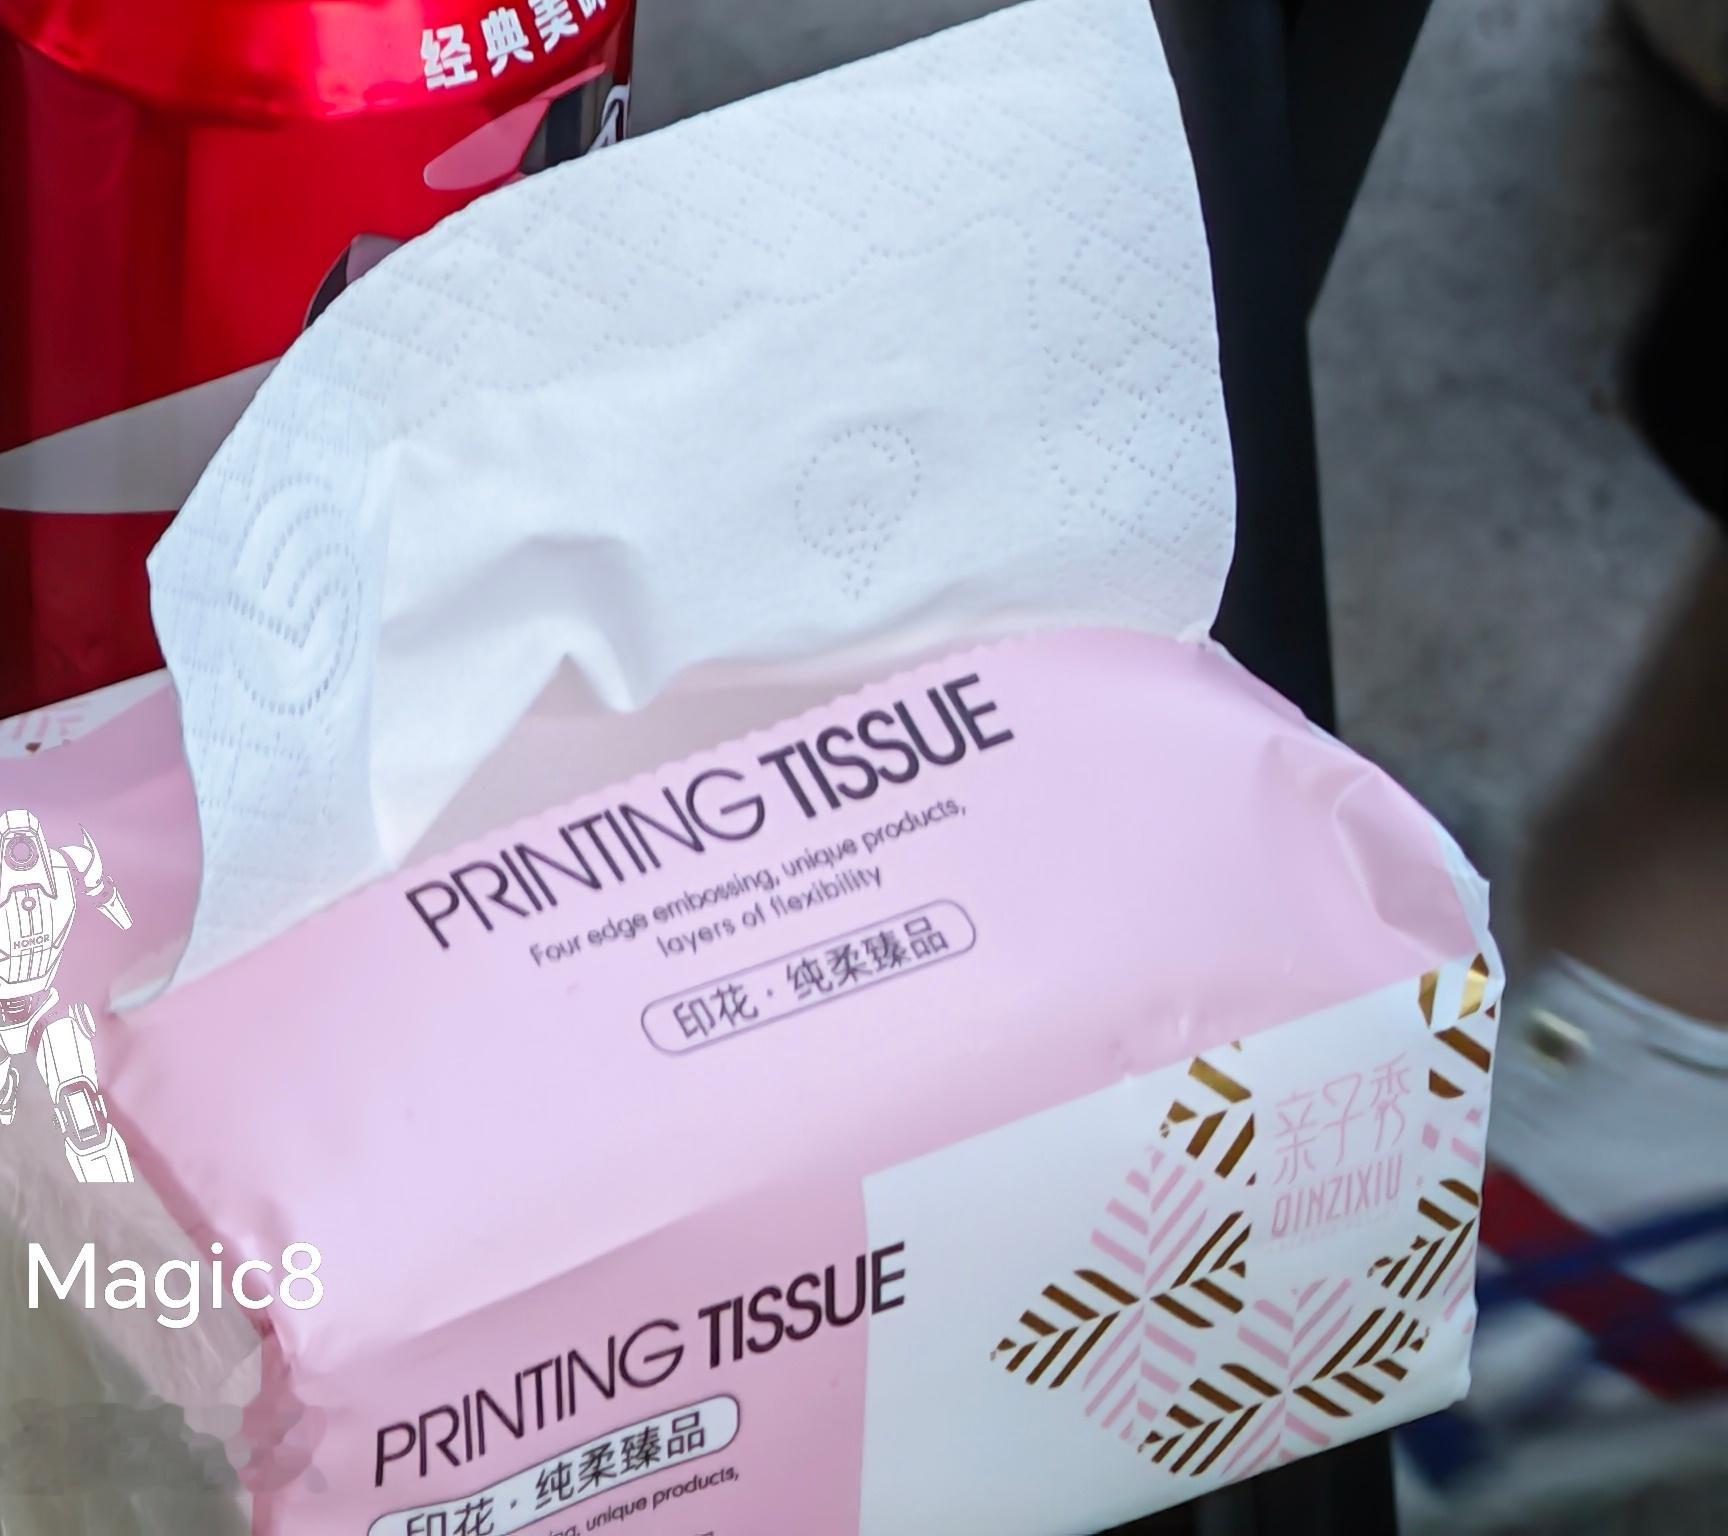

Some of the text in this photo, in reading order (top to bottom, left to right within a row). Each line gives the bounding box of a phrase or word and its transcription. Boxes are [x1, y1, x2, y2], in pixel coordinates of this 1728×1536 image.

[405, 672, 1014, 950] PRINTING TISSUE
[529, 798, 967, 967] Four edge embossing, unique products,
[656, 866, 882, 958] layers of flexibility
[1274, 1051, 1411, 1185] 亲子秀
[374, 1240, 907, 1487] PRINTING TISSUE
[585, 1496, 649, 1532] unique
[652, 1465, 741, 1510] products,
